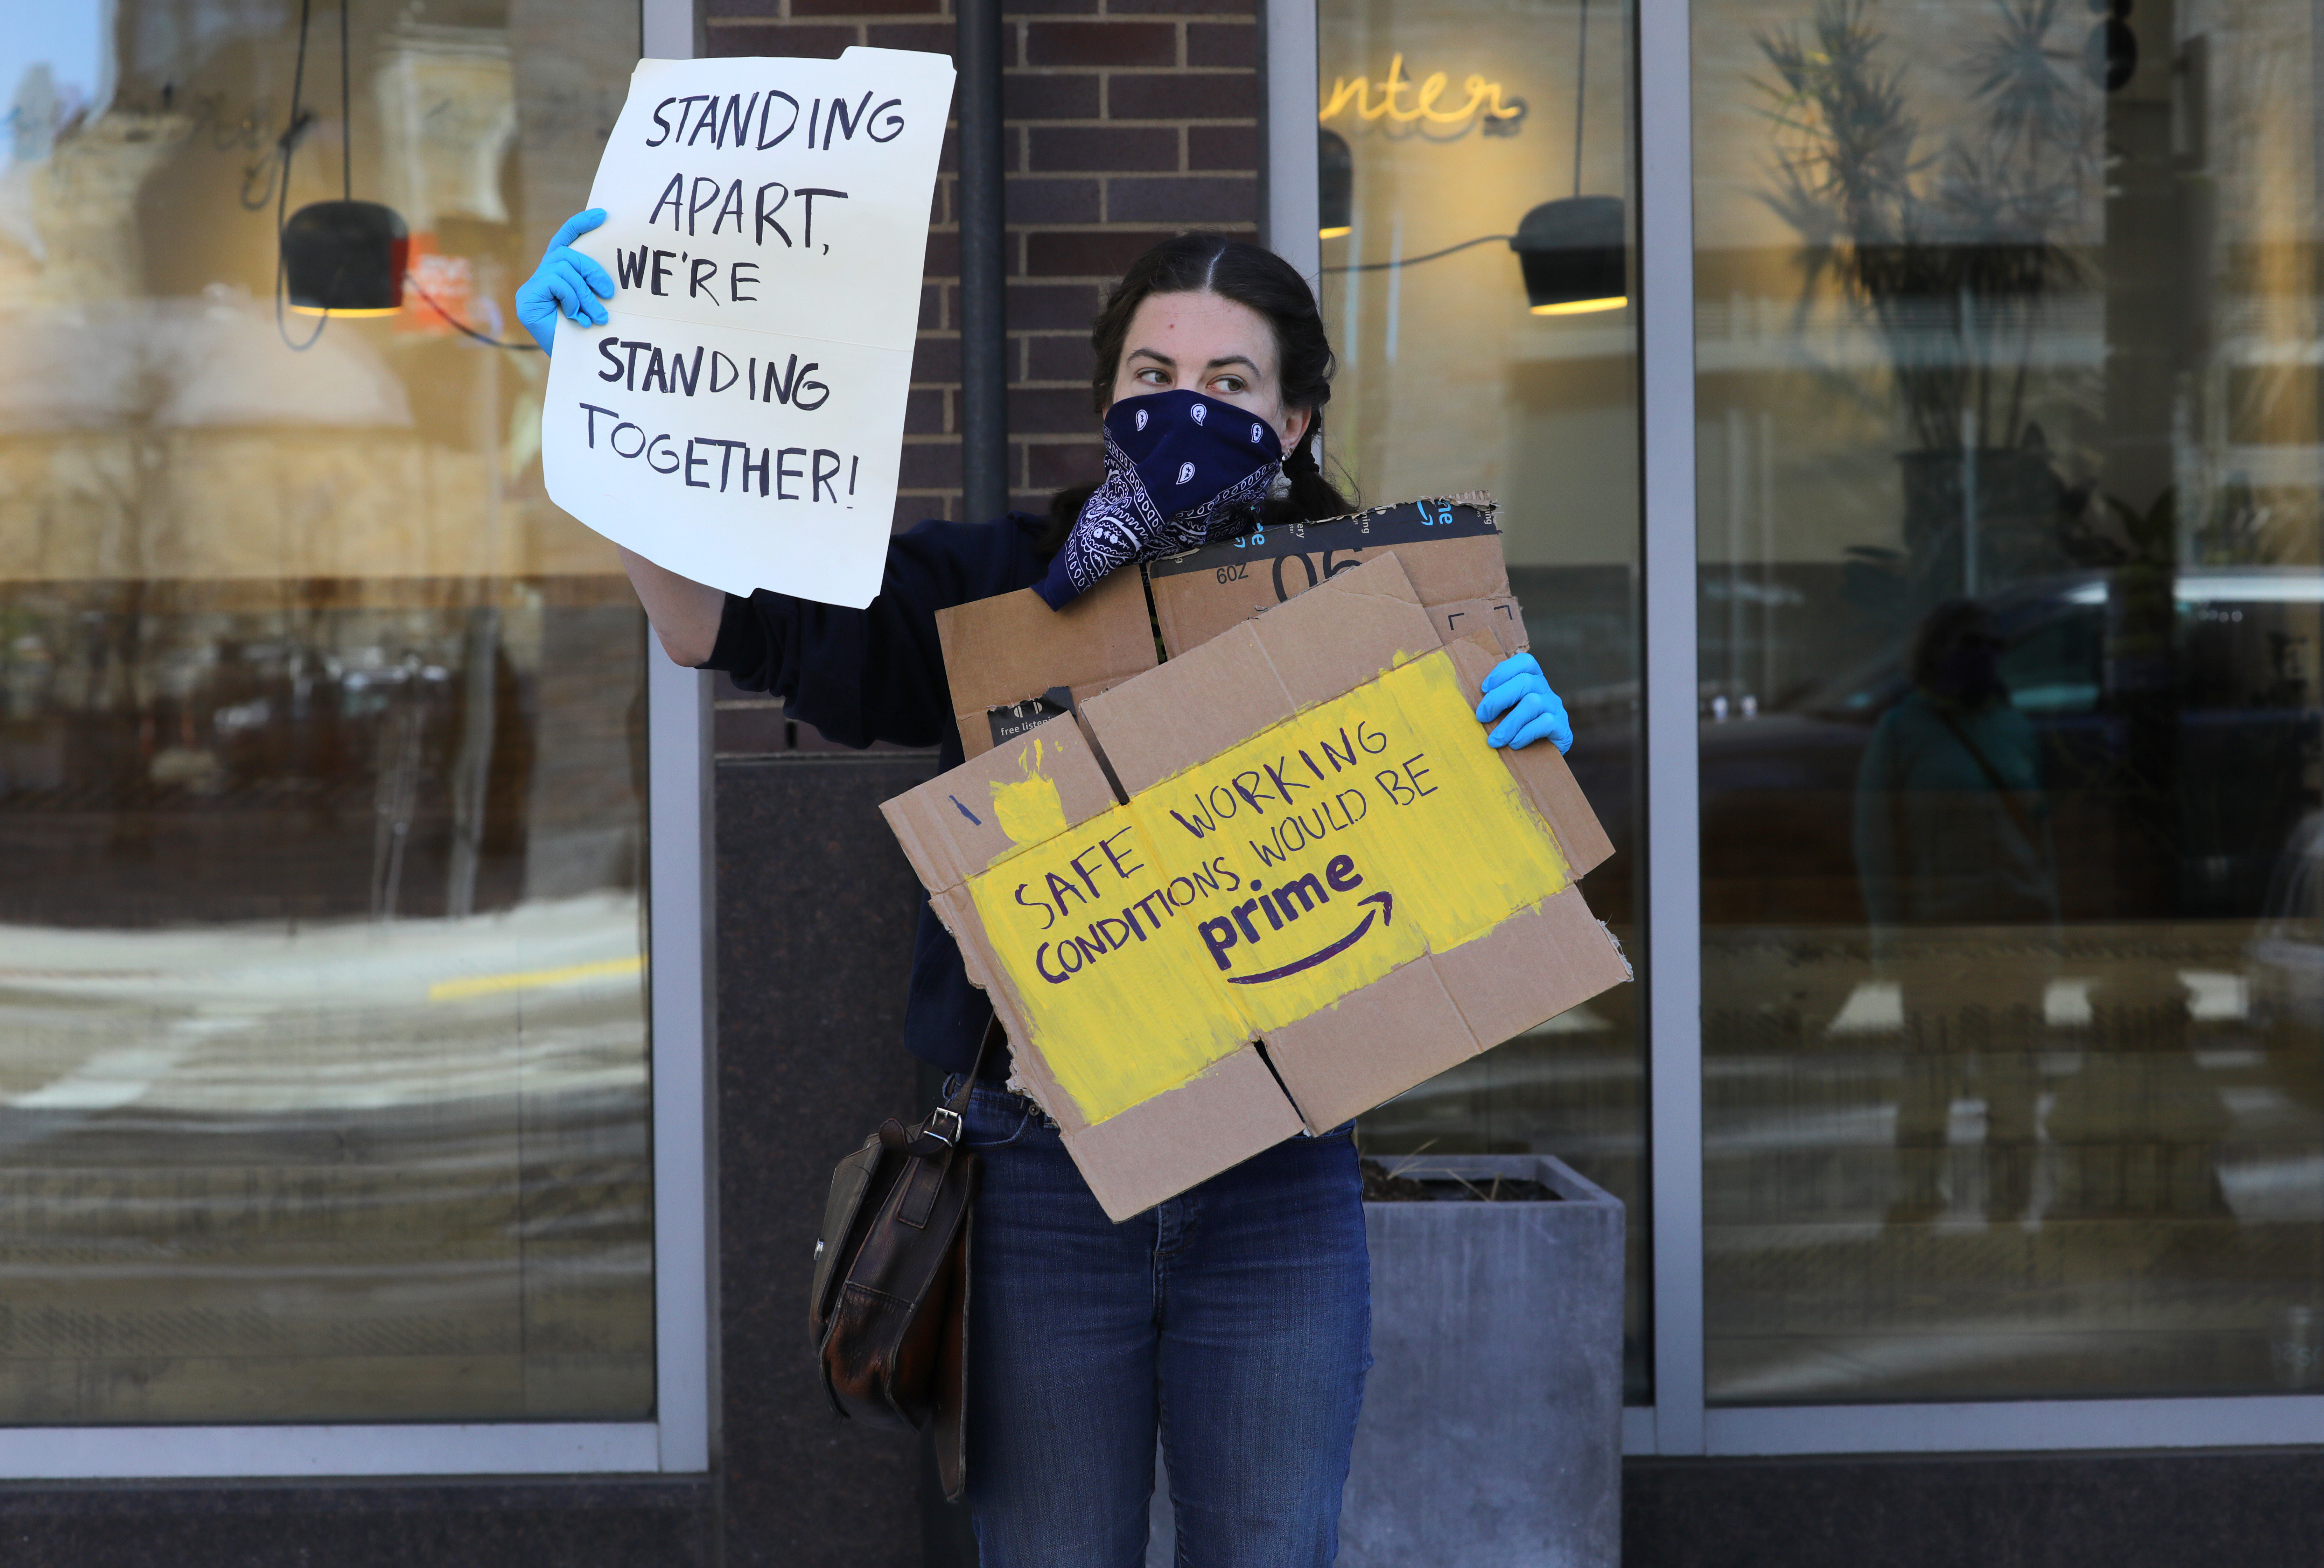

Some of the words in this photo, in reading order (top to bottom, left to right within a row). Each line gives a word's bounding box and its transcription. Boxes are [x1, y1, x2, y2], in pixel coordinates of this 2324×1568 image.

[646, 90, 905, 150] STANDING
[649, 173, 849, 255] APART,
[617, 244, 761, 306] WE'RE
[598, 337, 830, 411] STANDING
[579, 402, 859, 509] TOGETHER!
[1296, 523, 1304, 538] ery
[1000, 727, 1020, 736] free
[1014, 826, 1144, 930] SAFE
[1169, 721, 1387, 839] WORKING
[1036, 856, 1240, 984] CONDITIONS
[1248, 789, 1367, 868] WOULD
[1375, 753, 1438, 806] BE
[1198, 854, 1364, 971] prime
